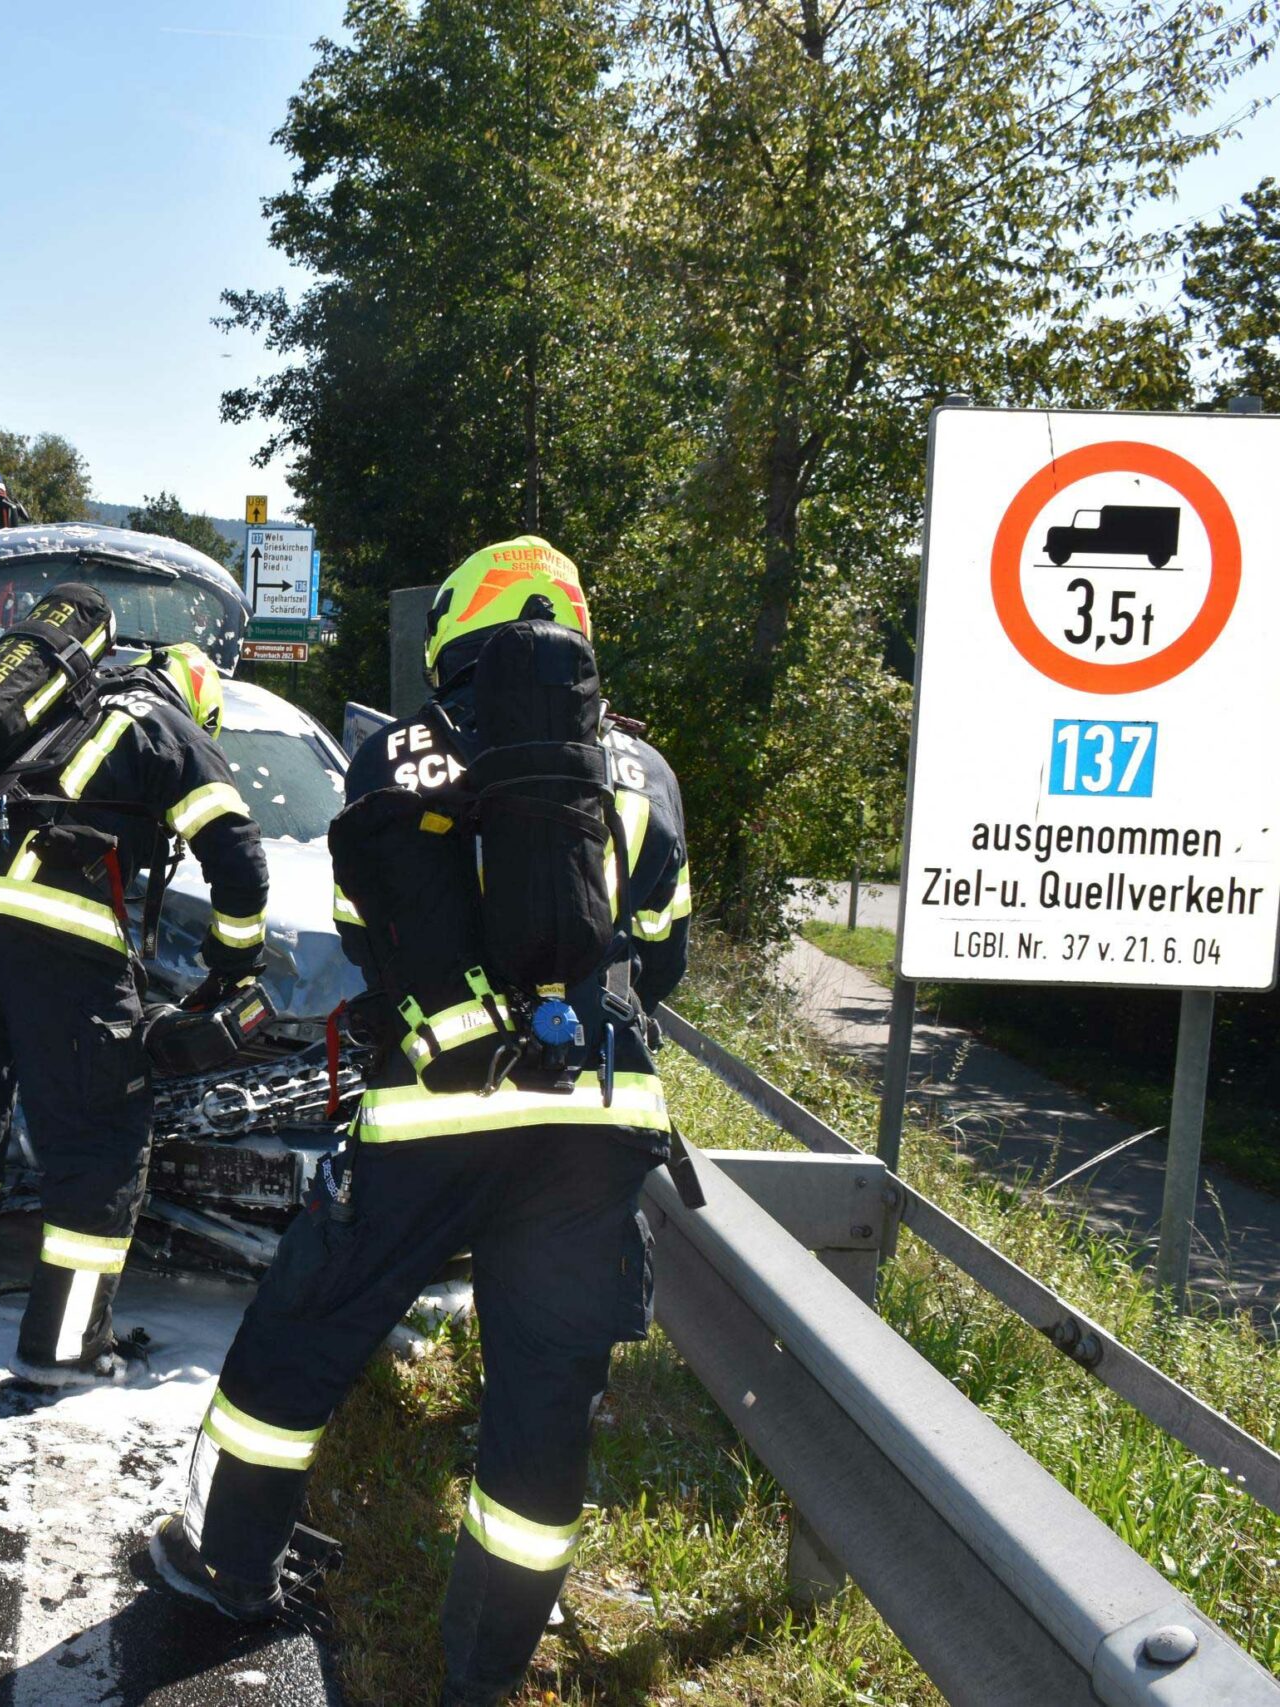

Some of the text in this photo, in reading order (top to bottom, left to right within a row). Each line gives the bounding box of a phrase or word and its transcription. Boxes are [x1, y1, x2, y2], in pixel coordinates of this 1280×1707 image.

[264, 533, 283, 541] Wels
[264, 543, 308, 551] Grieskirchen
[263, 553, 292, 561] Braunau
[263, 562, 280, 571] Ried
[270, 605, 307, 616] Schärding
[1056, 724, 1154, 793] 137
[971, 822, 1222, 863] ausgenommen
[1039, 870, 1265, 915] Quellverkehr
[1017, 932, 1048, 960] Nr.
[1061, 933, 1091, 961] 37
[1097, 942, 1115, 962] v.
[1192, 937, 1221, 965] 04
